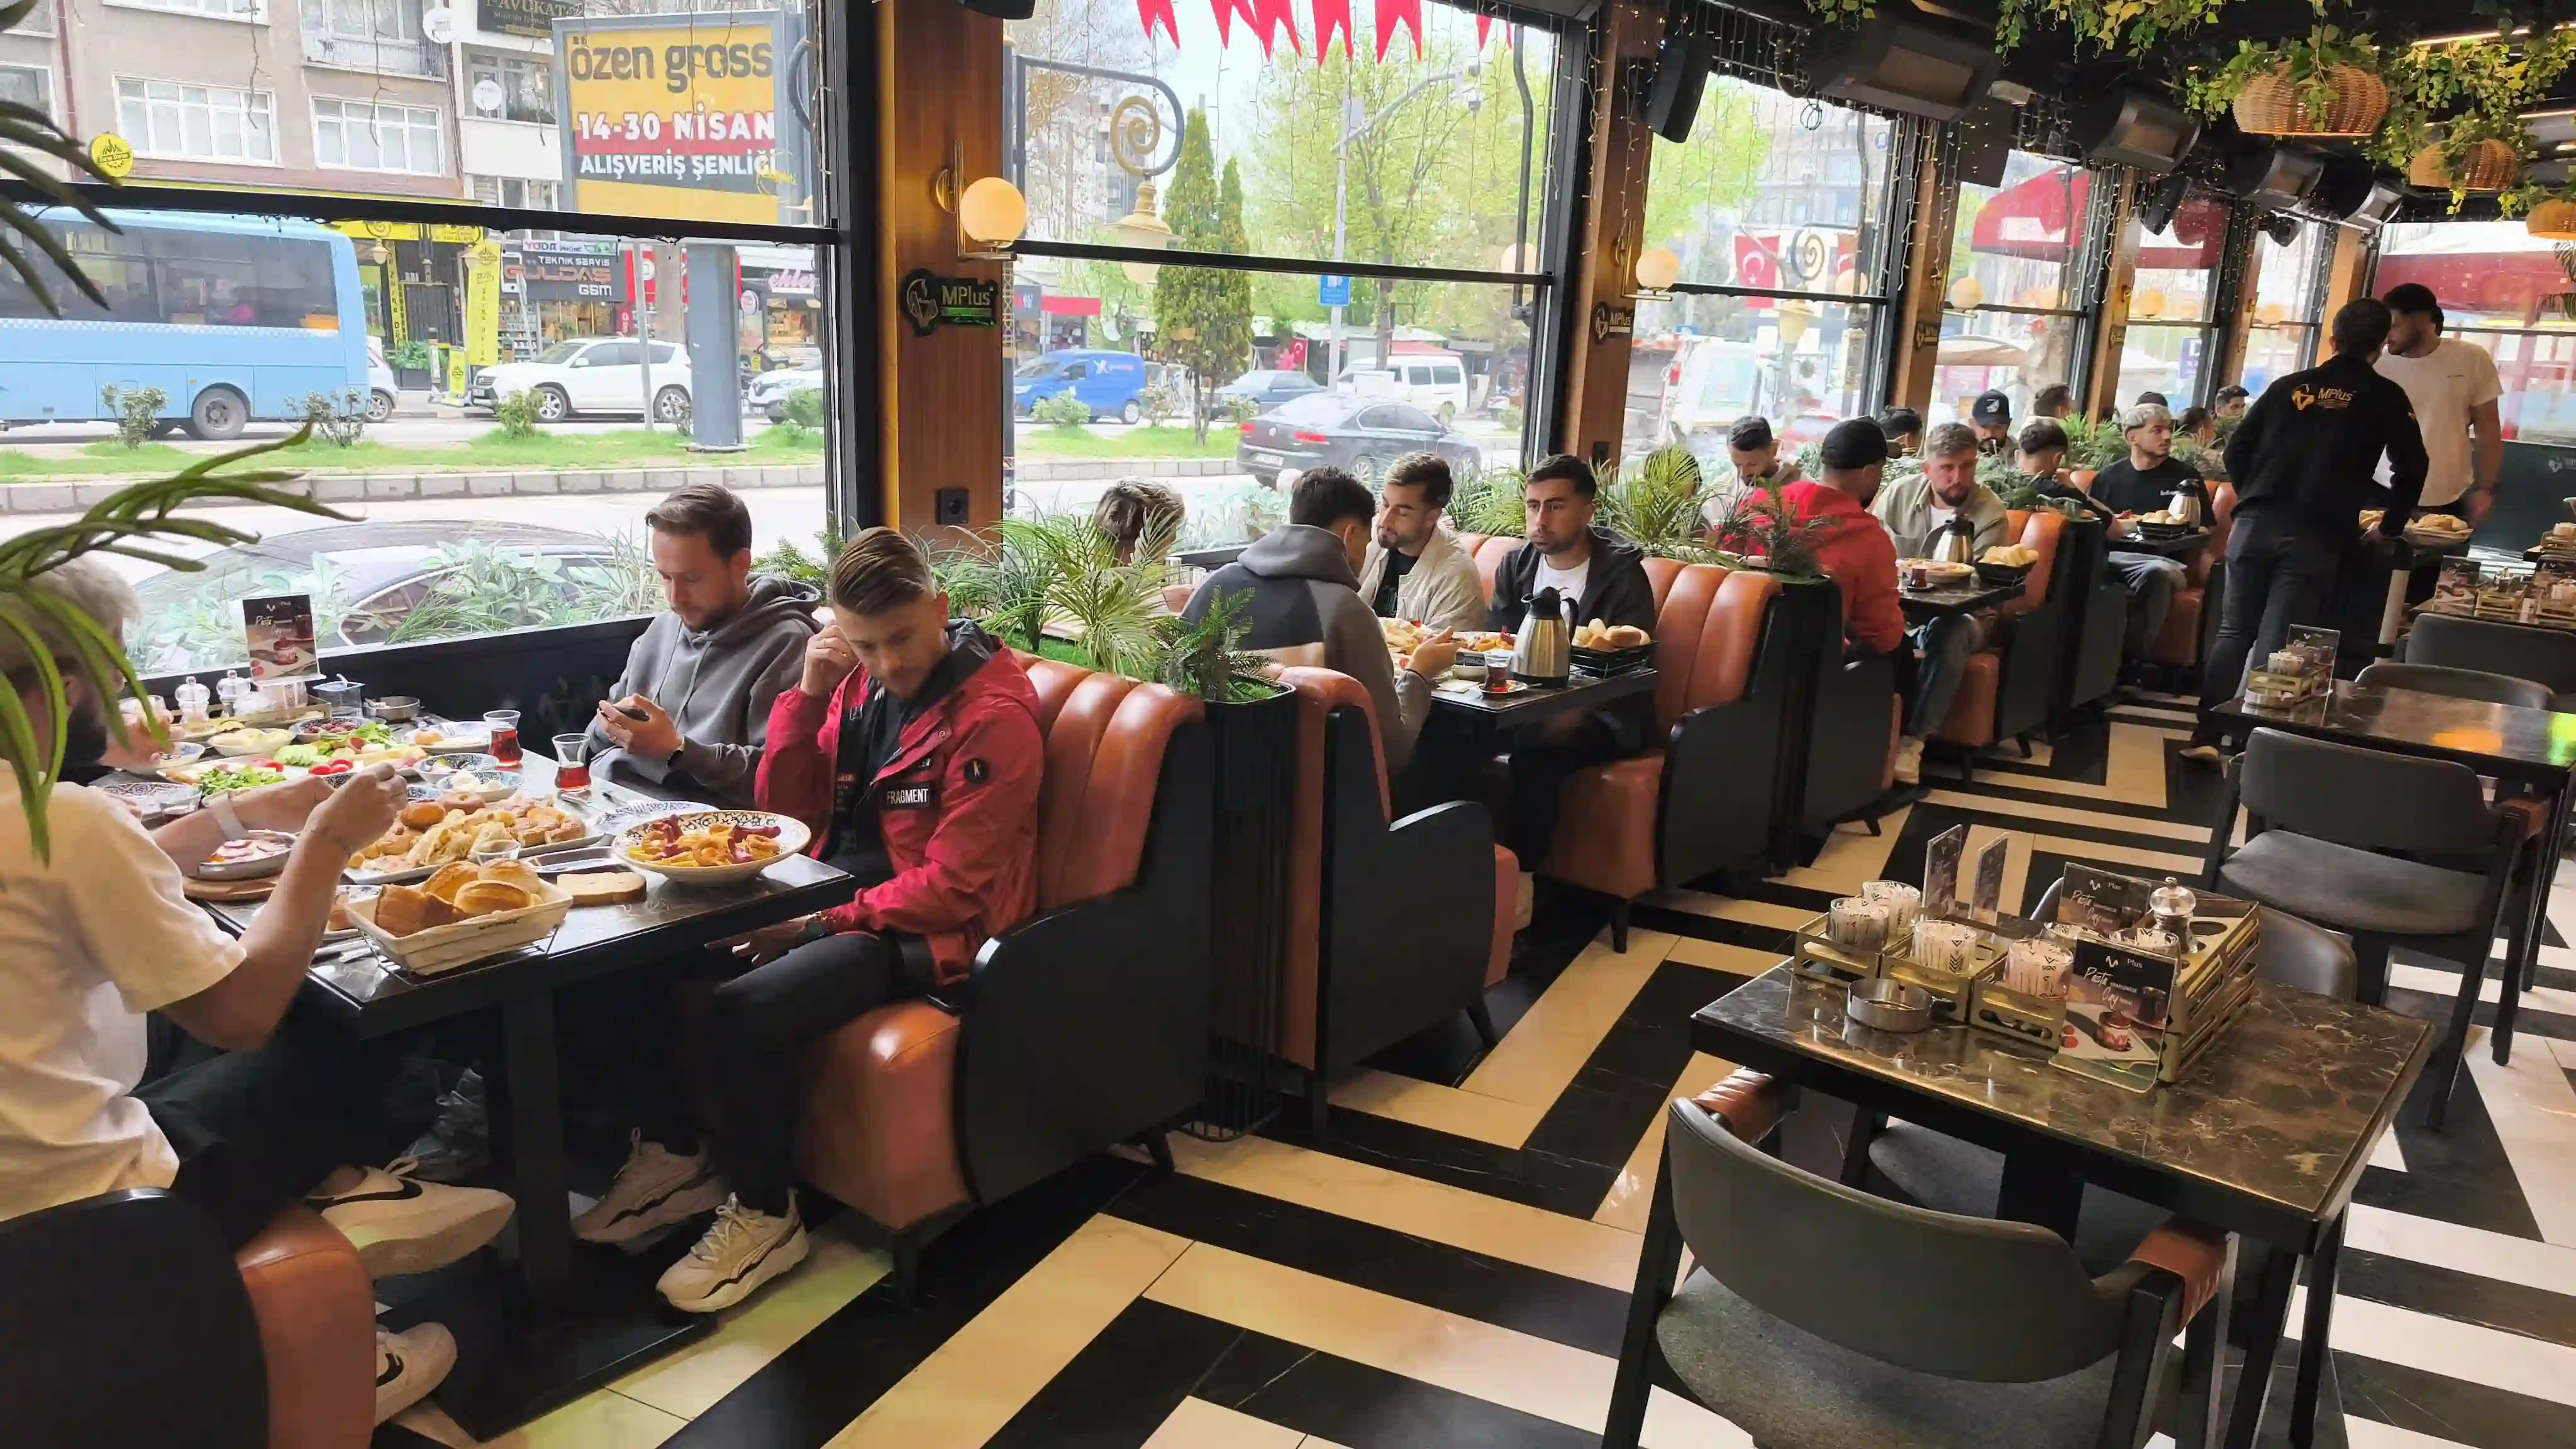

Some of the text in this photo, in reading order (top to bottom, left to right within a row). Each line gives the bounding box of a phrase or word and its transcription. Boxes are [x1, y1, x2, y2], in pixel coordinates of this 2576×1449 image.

[570, 36, 773, 93] özen gross
[577, 101, 775, 140] 14-30 NİSAN
[579, 148, 686, 180] ALIŞVERİŞ
[579, 284, 612, 296] GSM
[941, 285, 991, 306] MPlus
[2317, 387, 2353, 401] MPlus
[887, 788, 929, 804] FRAGMENT
[2126, 958, 2143, 969] Plus
